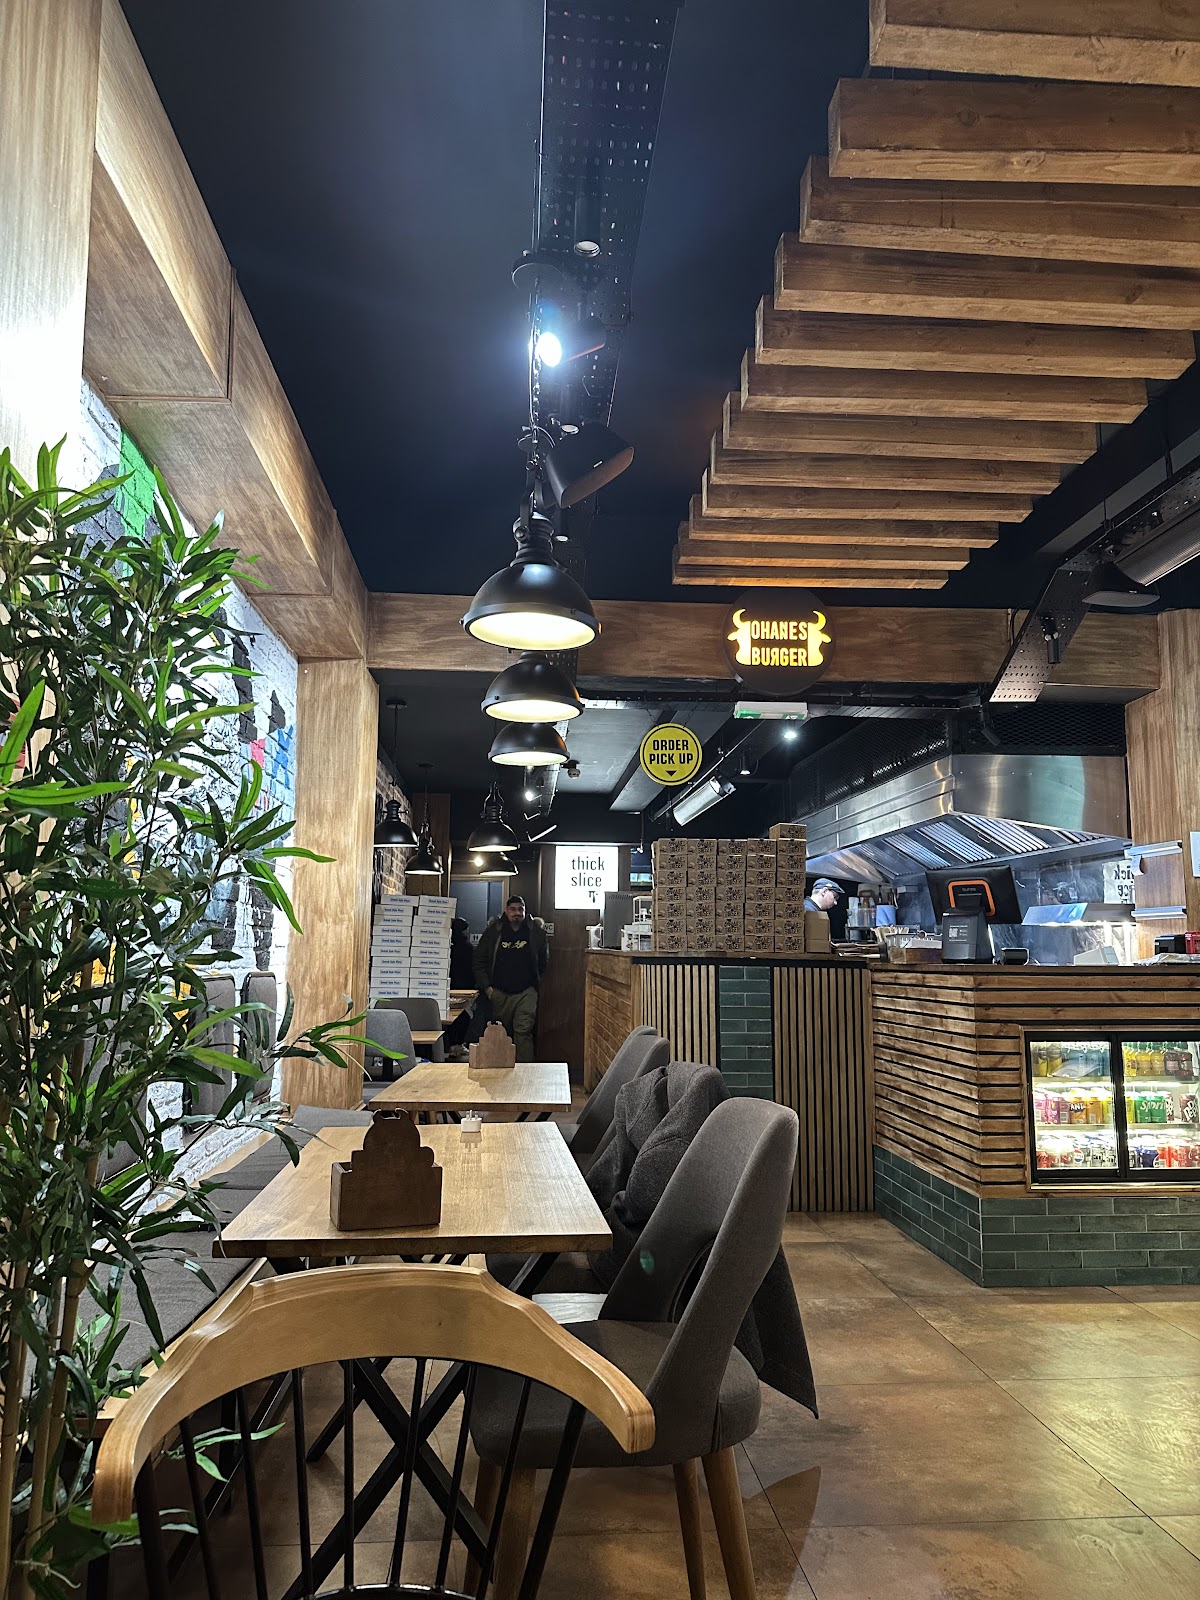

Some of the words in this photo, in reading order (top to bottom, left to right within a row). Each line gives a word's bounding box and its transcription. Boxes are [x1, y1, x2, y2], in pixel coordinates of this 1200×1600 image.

[751, 647, 808, 666] BURGER
[652, 739, 689, 751] ORDER
[649, 753, 676, 765] PICK
[679, 753, 694, 765] UP
[571, 856, 605, 871] thick
[571, 872, 602, 887] slice
